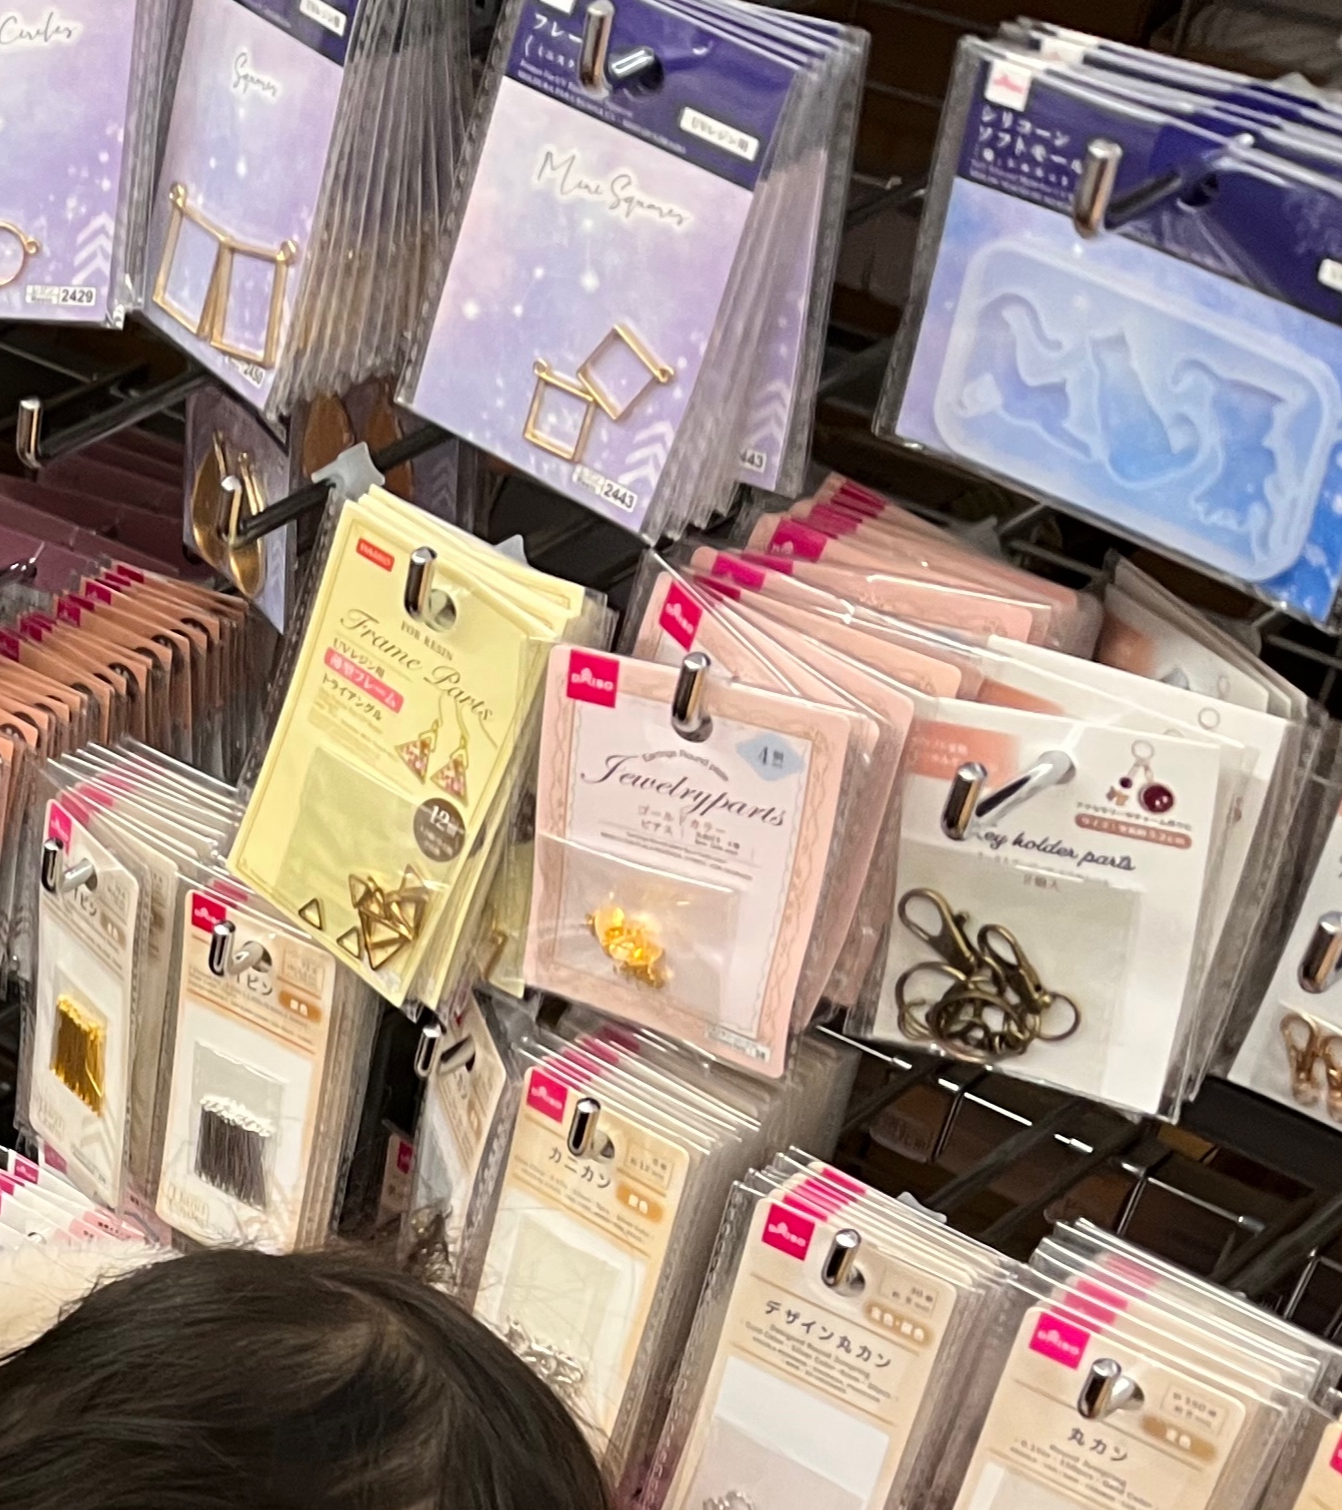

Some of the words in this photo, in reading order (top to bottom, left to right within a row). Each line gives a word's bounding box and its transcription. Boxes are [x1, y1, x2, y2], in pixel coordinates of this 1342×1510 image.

[61, 288, 94, 304] 2429
[604, 482, 635, 511] 2443
[333, 637, 385, 679] UVレジン用
[400, 620, 421, 641] FOR
[423, 634, 454, 662] RESIN
[340, 608, 423, 671] Frame
[423, 665, 493, 721] Parts
[571, 667, 616, 692] DAISO
[1011, 831, 1078, 859] holder
[1077, 848, 1136, 872] parts
[549, 1146, 611, 1190] カニカン
[764, 1299, 892, 1369] デザイン丸カン
[1067, 1426, 1129, 1463] 丸カン
